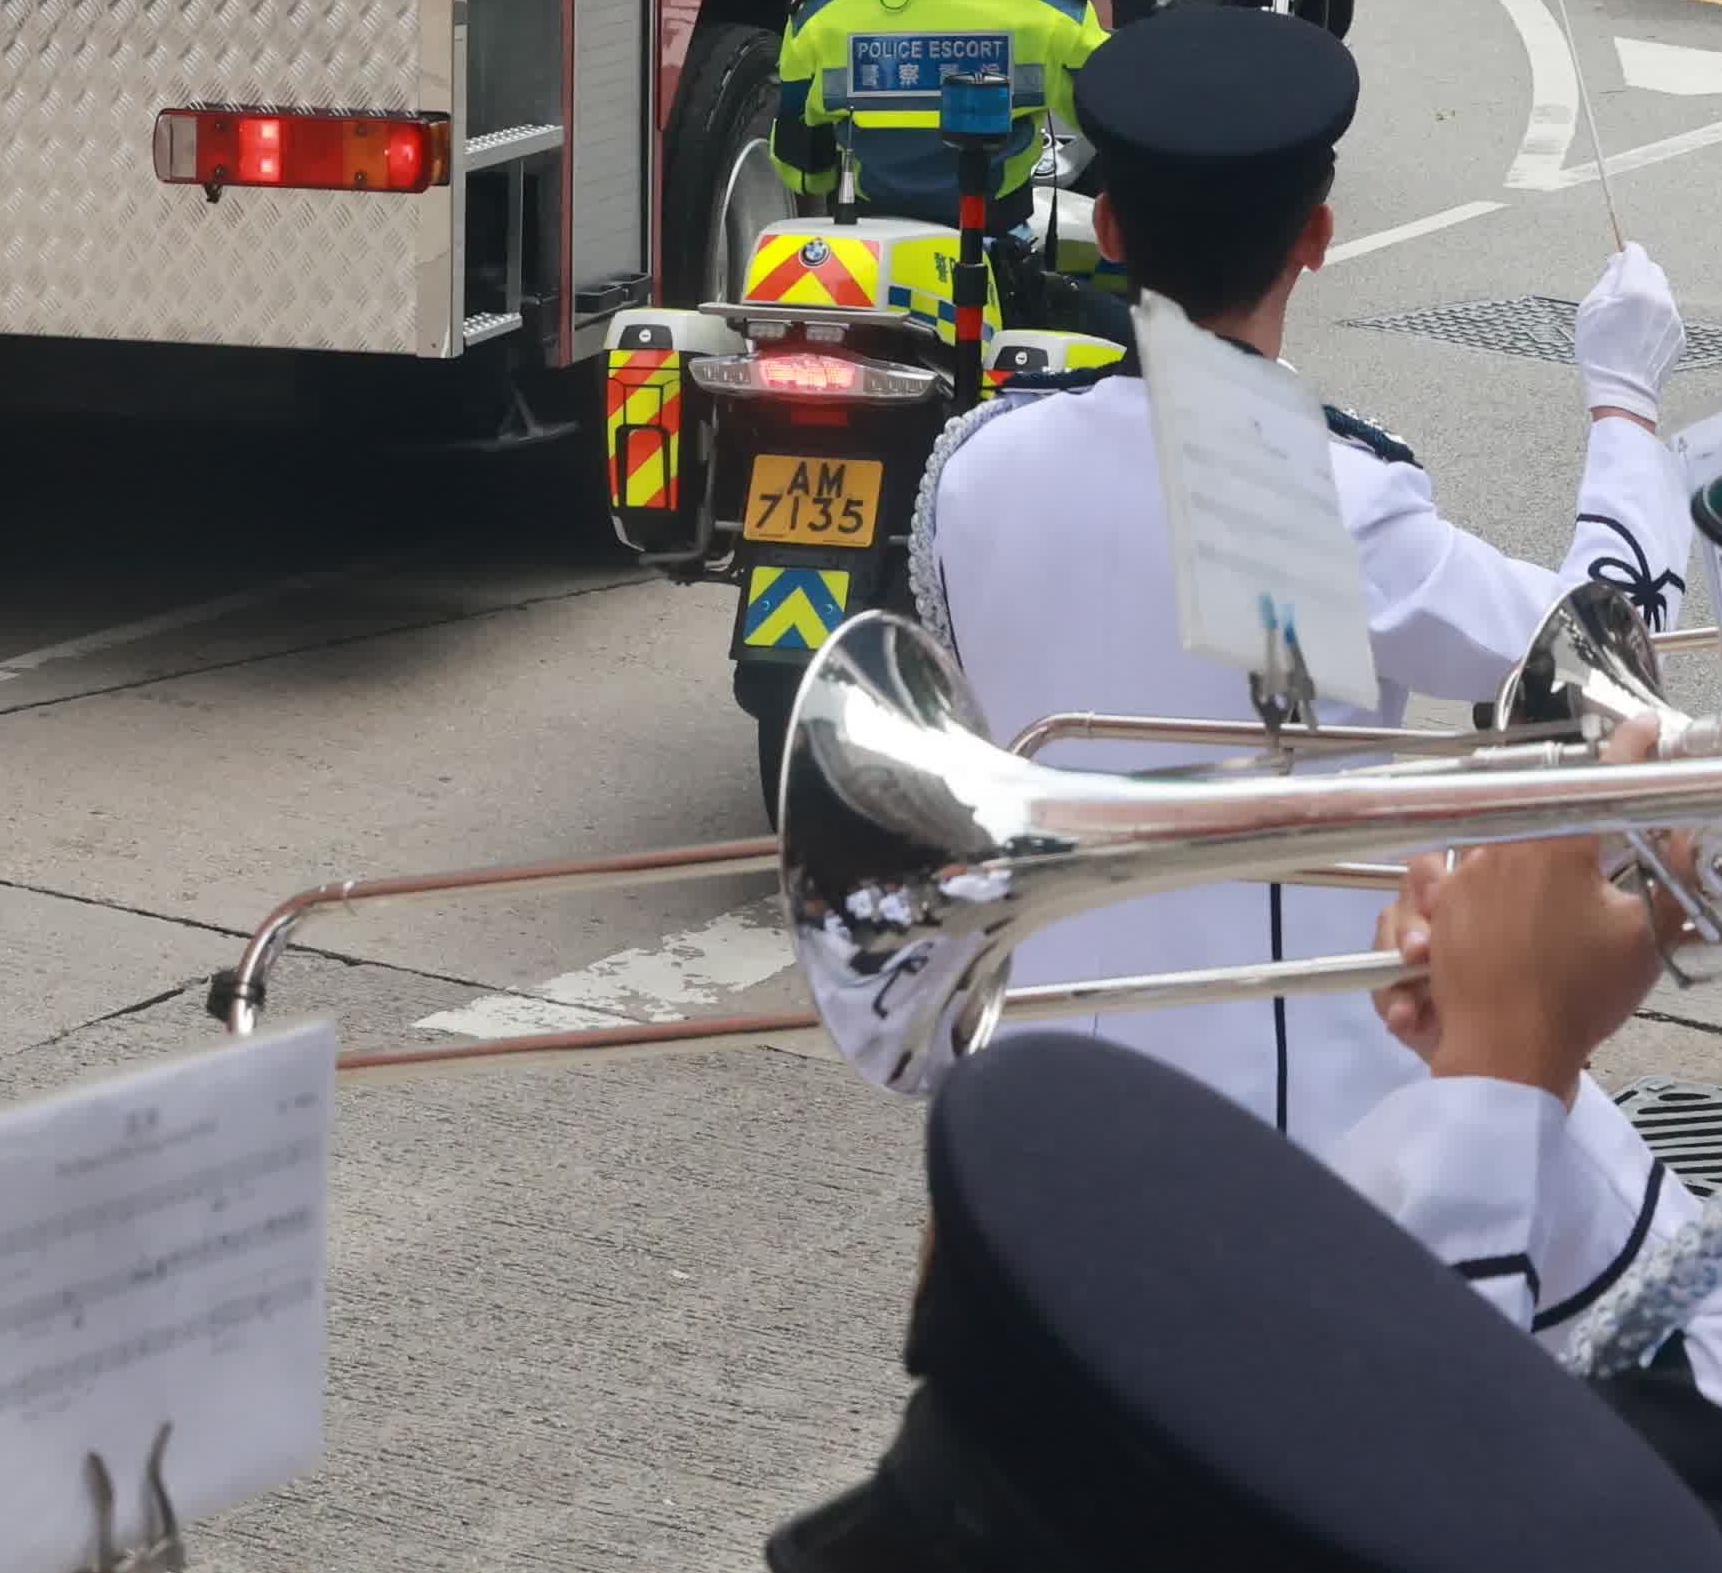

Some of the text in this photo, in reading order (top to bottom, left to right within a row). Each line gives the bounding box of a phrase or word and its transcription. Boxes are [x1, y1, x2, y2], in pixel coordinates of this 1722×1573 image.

[857, 40, 1004, 59] POLICE ESCORT
[786, 460, 846, 499] AM
[756, 493, 864, 534] 7135
